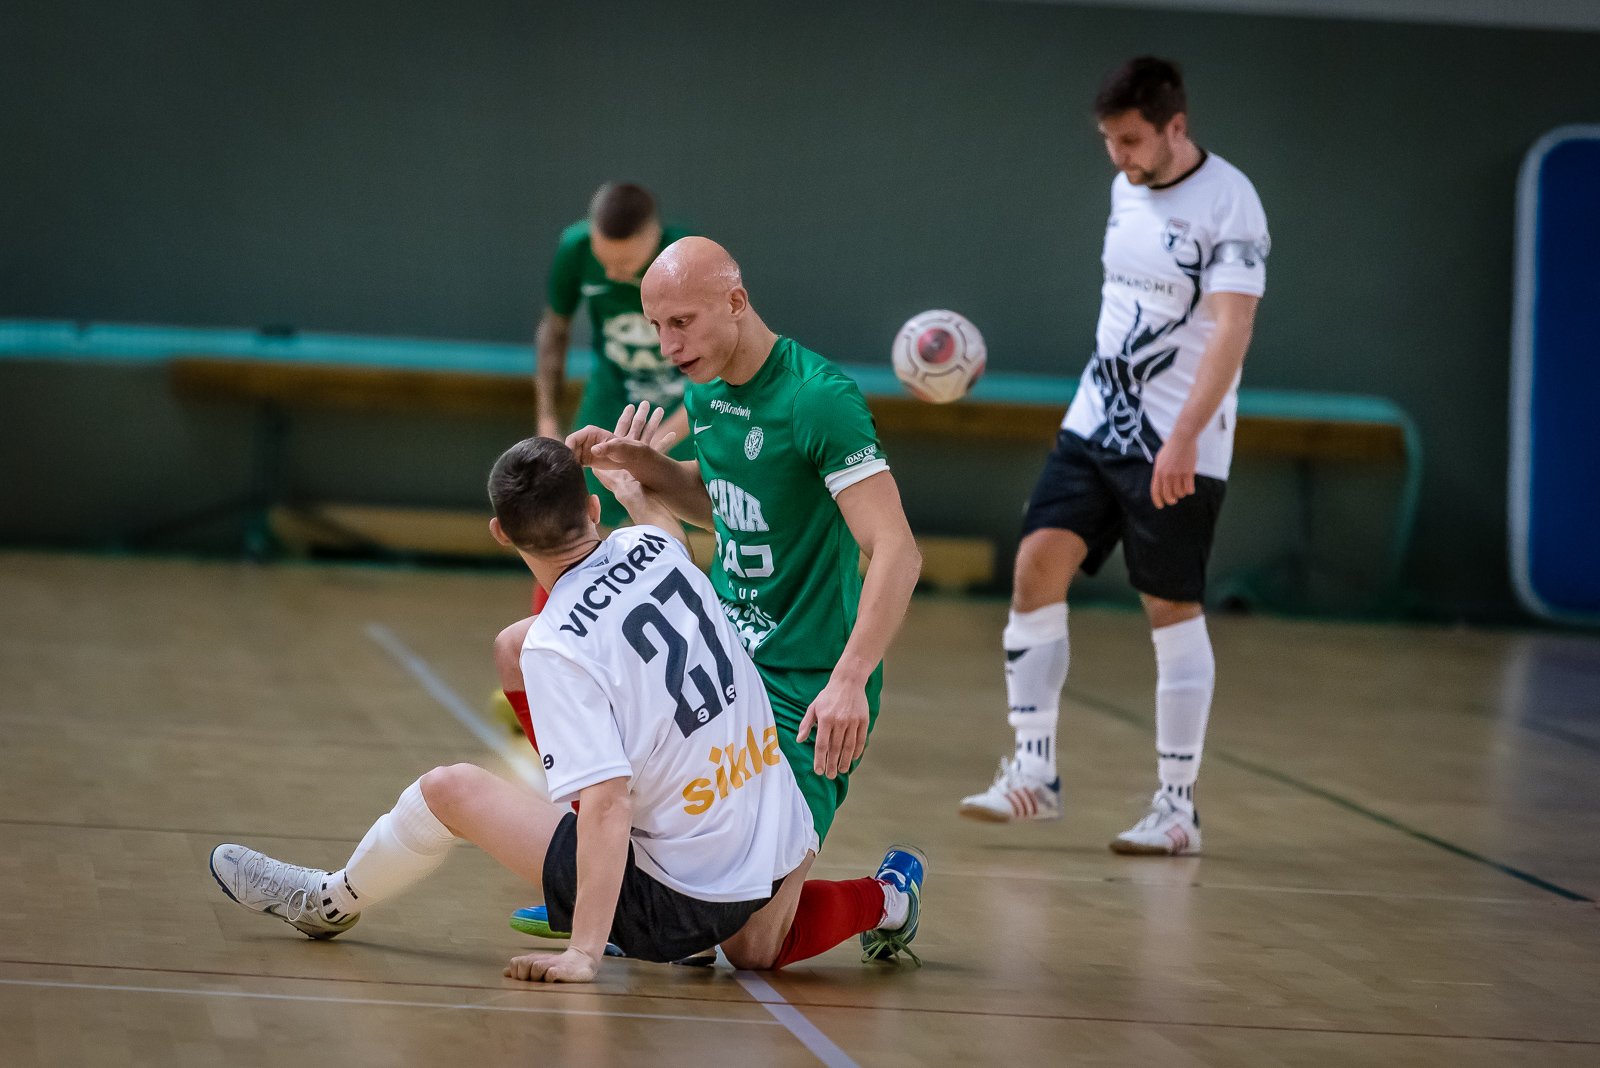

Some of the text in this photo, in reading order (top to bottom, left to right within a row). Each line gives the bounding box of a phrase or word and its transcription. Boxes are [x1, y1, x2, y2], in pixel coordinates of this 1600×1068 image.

[559, 533, 669, 638] VICTORIA
[621, 566, 738, 739] 27
[682, 725, 781, 816] sikla
